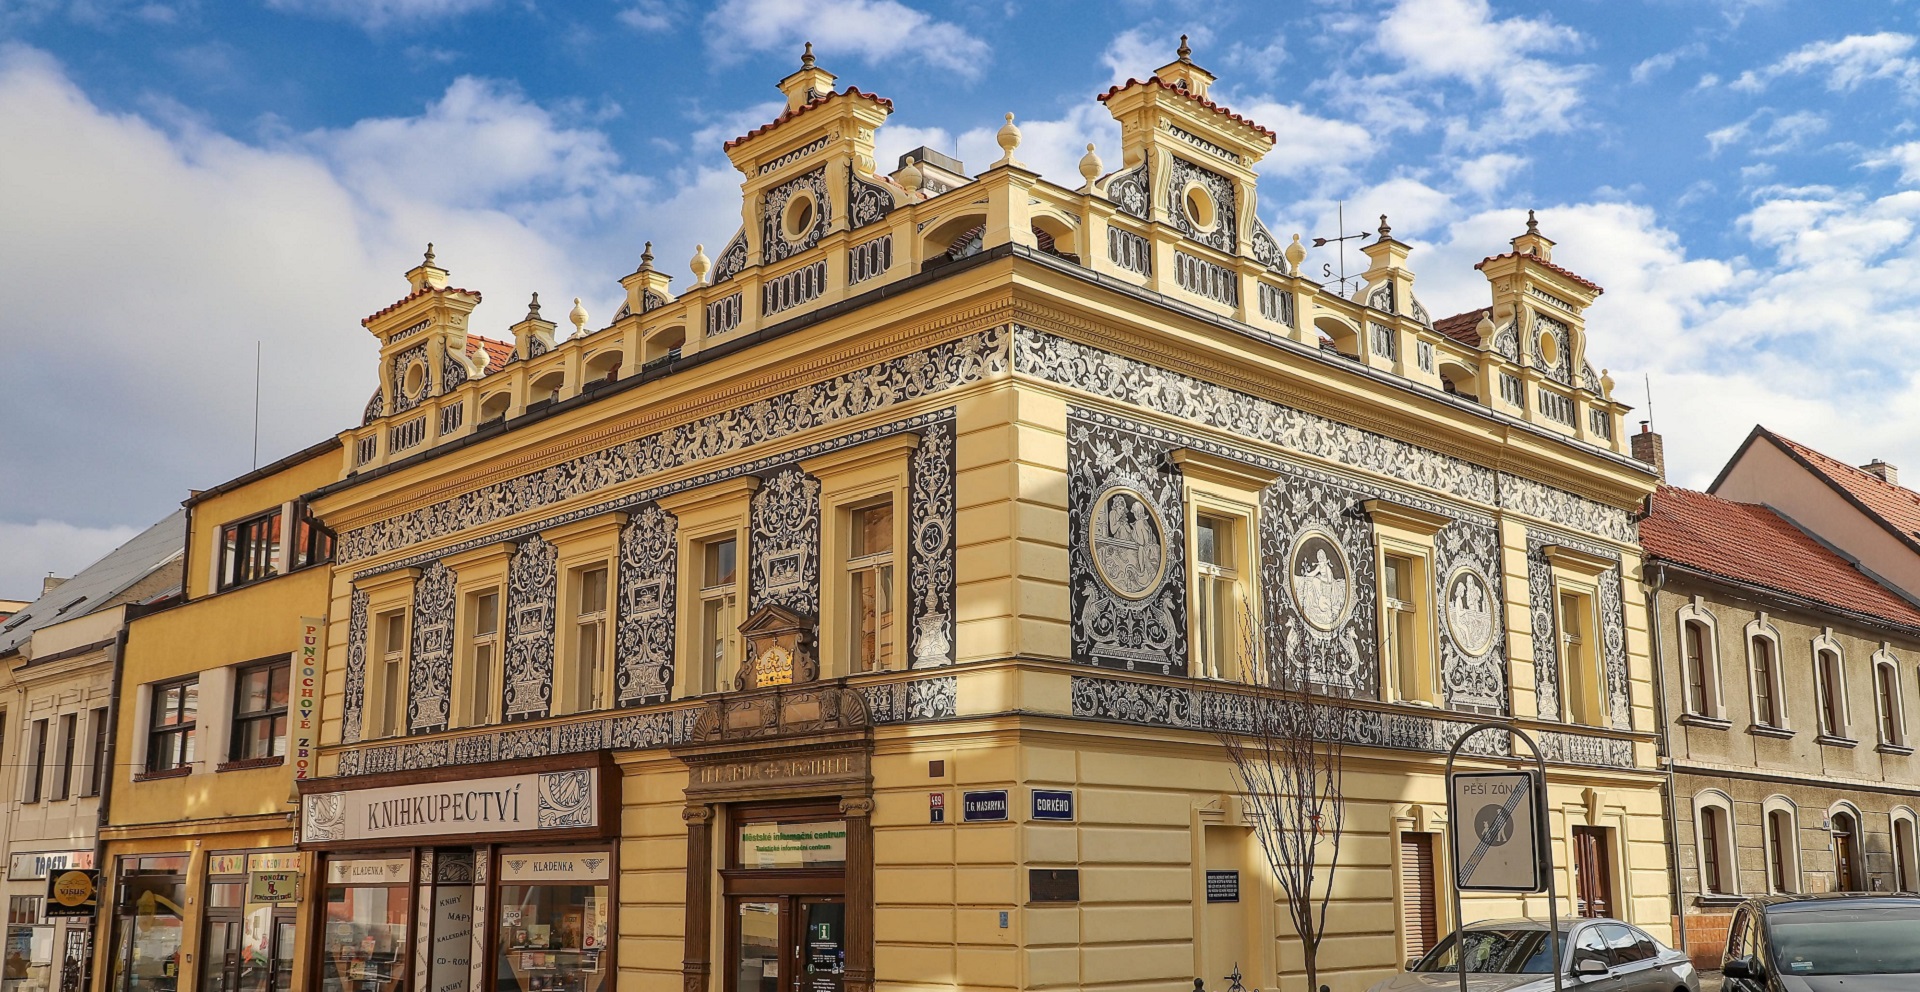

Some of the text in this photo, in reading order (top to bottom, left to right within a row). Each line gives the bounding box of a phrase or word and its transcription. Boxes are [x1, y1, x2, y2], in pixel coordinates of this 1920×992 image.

[300, 625, 317, 730] PUNČOCHOVÉ
[782, 757, 852, 777] APOTHEKE
[1463, 782, 1518, 795] PĚŠÍ ZÓN
[368, 783, 521, 831] KNIHKUPECTVÍ
[976, 800, 1006, 812] MASARYKA
[1037, 797, 1069, 812] GORKÉHO
[934, 810, 939, 820] 1
[742, 830, 846, 842] Městské informační centrum
[352, 866, 384, 876] KLADENKA
[533, 861, 574, 872] KLADENKA
[260, 873, 289, 882] PONOŽKY
[440, 895, 462, 907] KNIHY
[447, 912, 471, 922] MAPY
[440, 980, 463, 992] KNIHY
